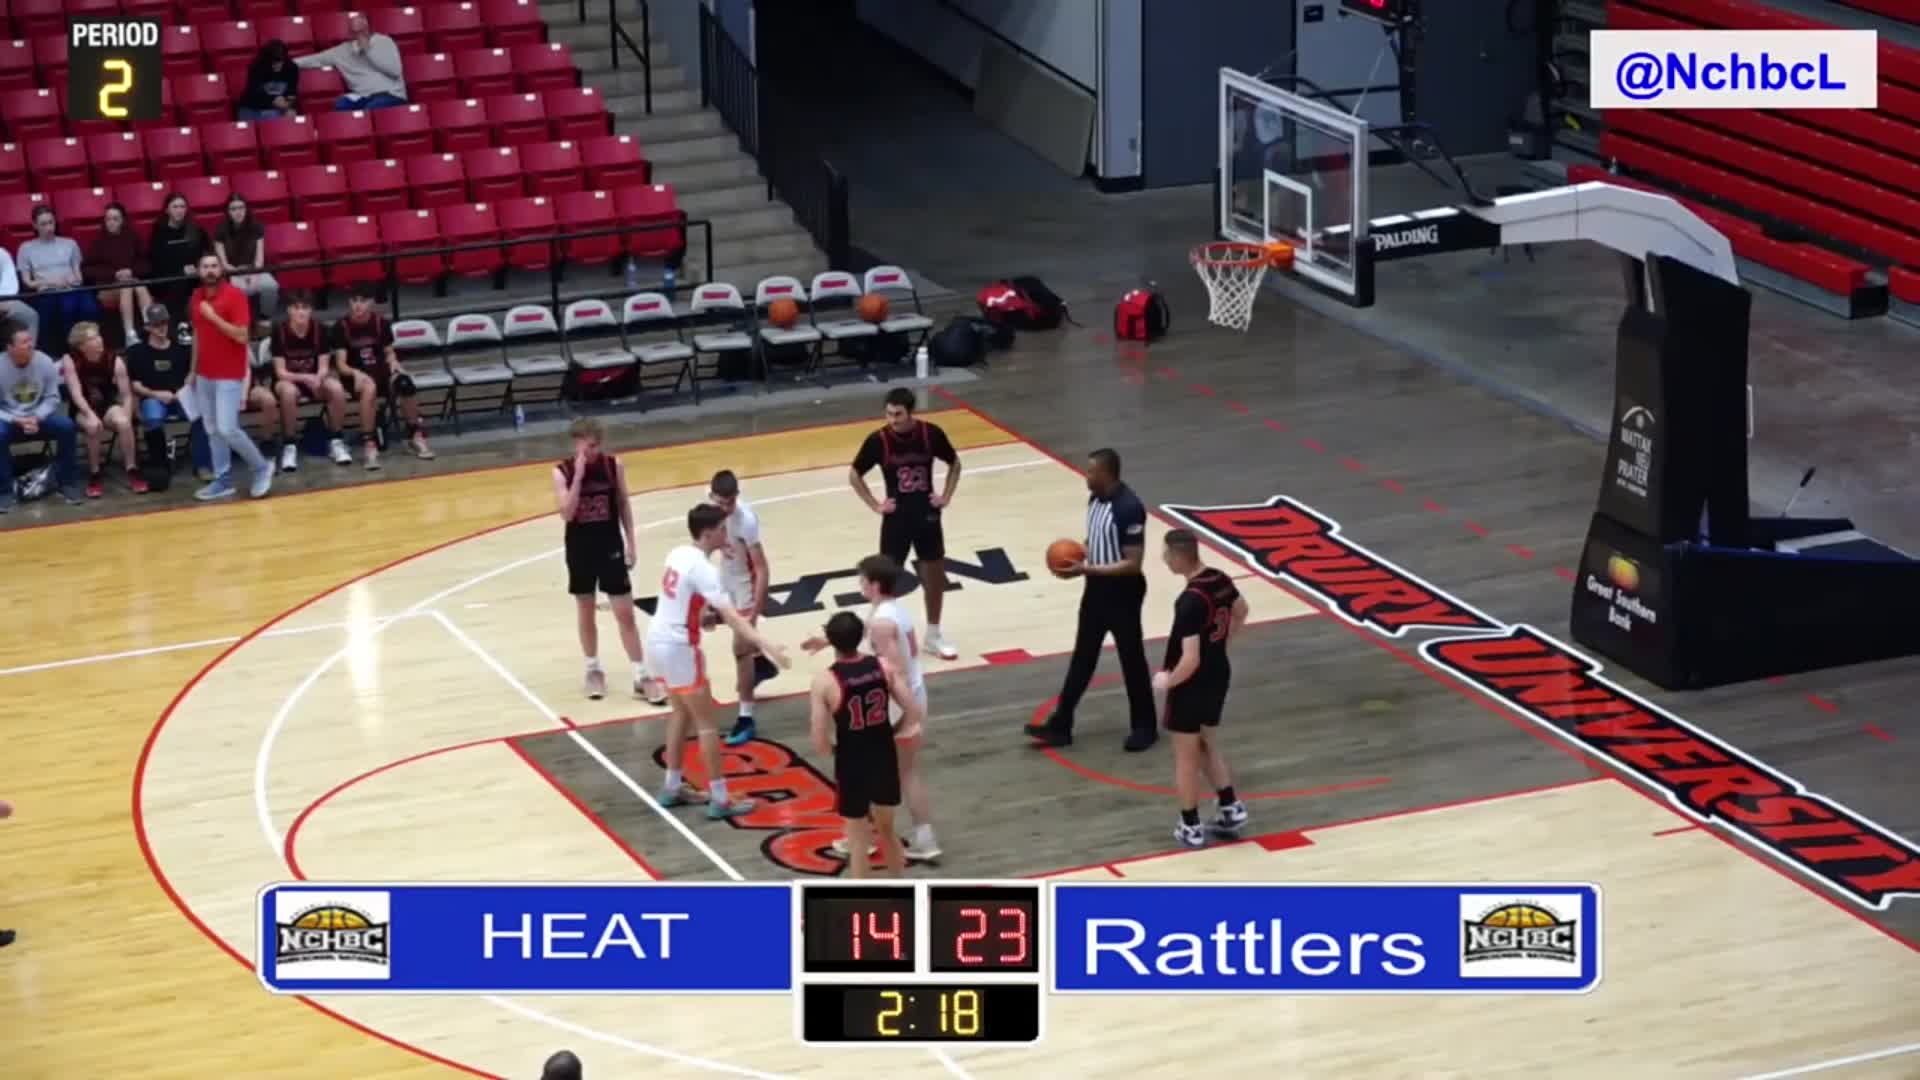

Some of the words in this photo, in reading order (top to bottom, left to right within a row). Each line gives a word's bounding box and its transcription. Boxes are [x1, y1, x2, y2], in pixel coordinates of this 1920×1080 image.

[1370, 224, 1439, 251] PALDING
[1586, 573, 1614, 601] Great
[1615, 588, 1657, 624] Southern
[1608, 605, 1633, 632] Bank
[847, 688, 887, 730] 12
[1190, 502, 1505, 635] DRURY
[1432, 628, 1920, 899] UNIVERSITY
